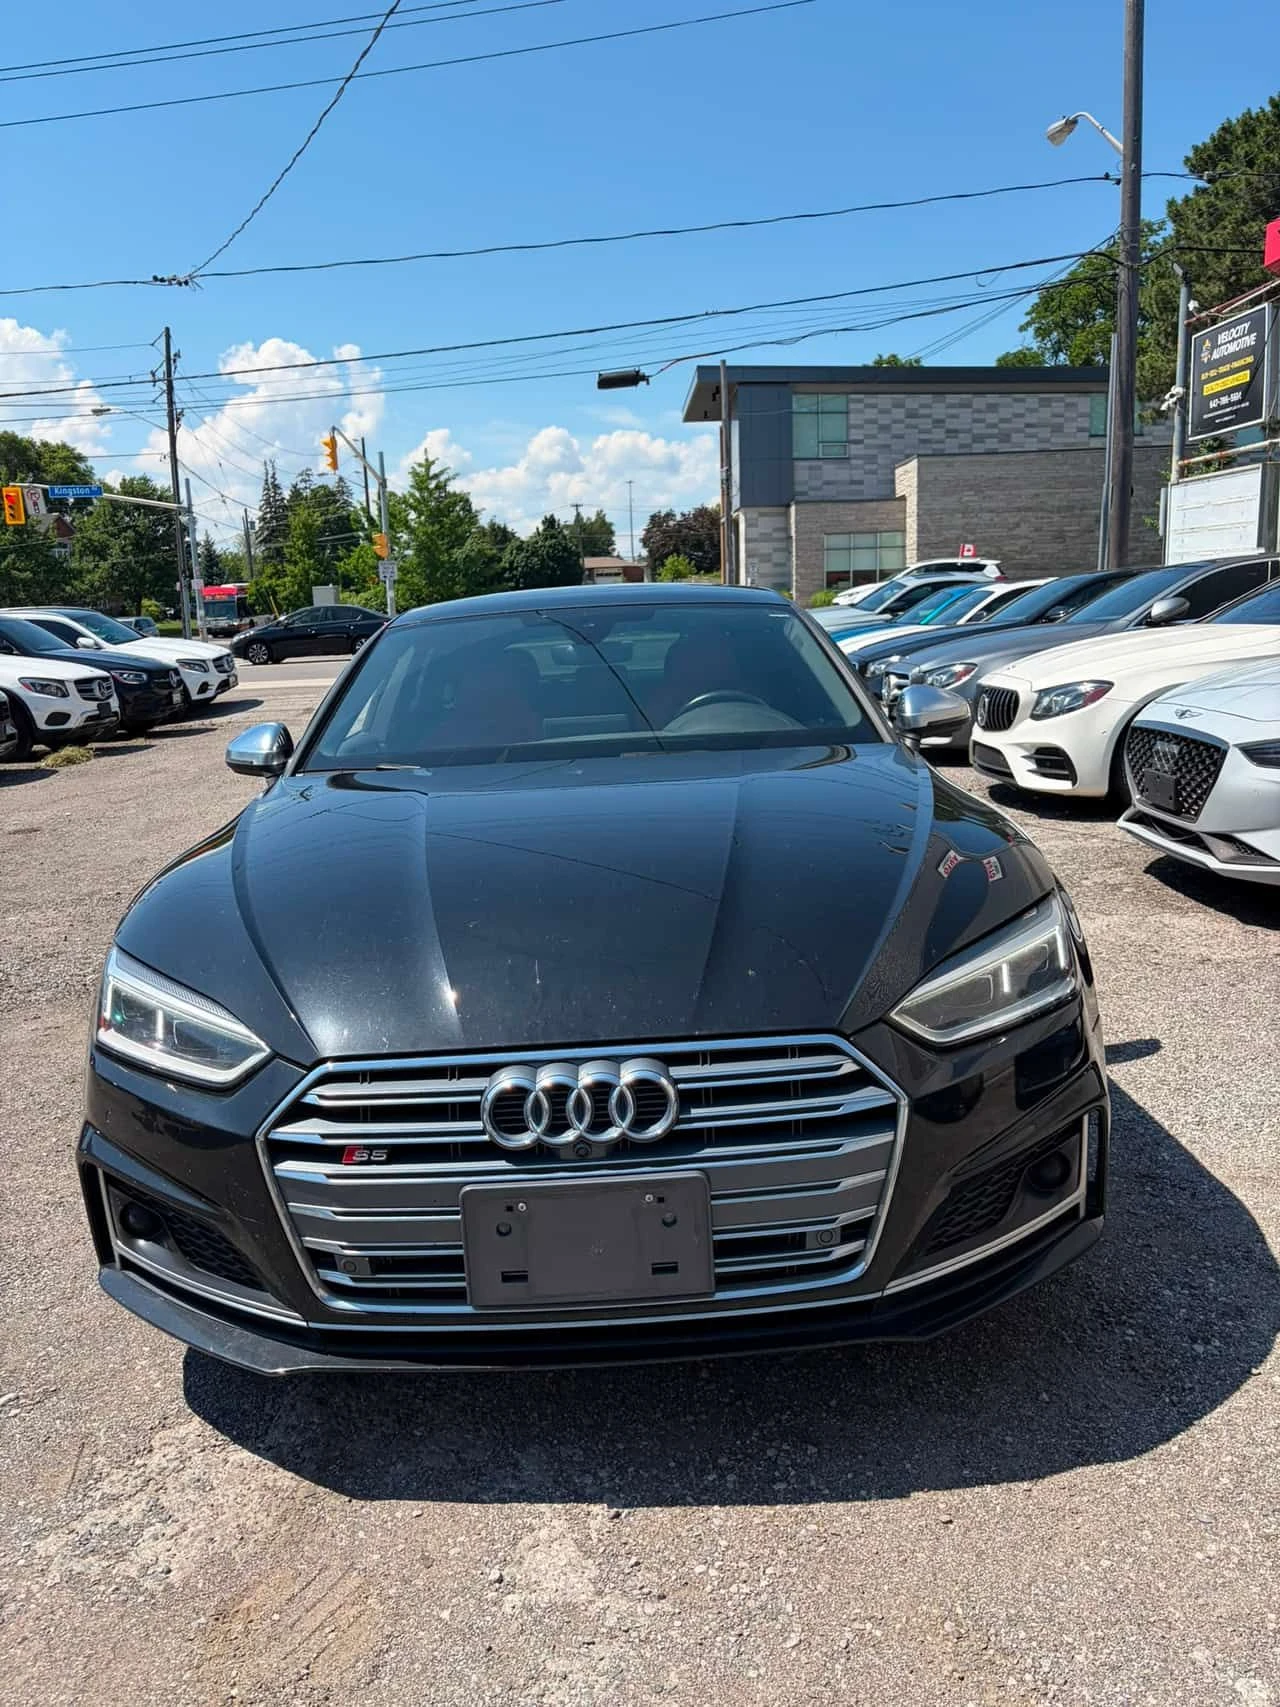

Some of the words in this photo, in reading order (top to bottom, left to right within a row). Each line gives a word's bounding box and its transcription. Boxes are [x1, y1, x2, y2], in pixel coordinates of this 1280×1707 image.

[1218, 321, 1251, 345] VELOCITY
[1211, 333, 1257, 360] AUTOMOTIVE
[54, 487, 90, 497] Kingston
